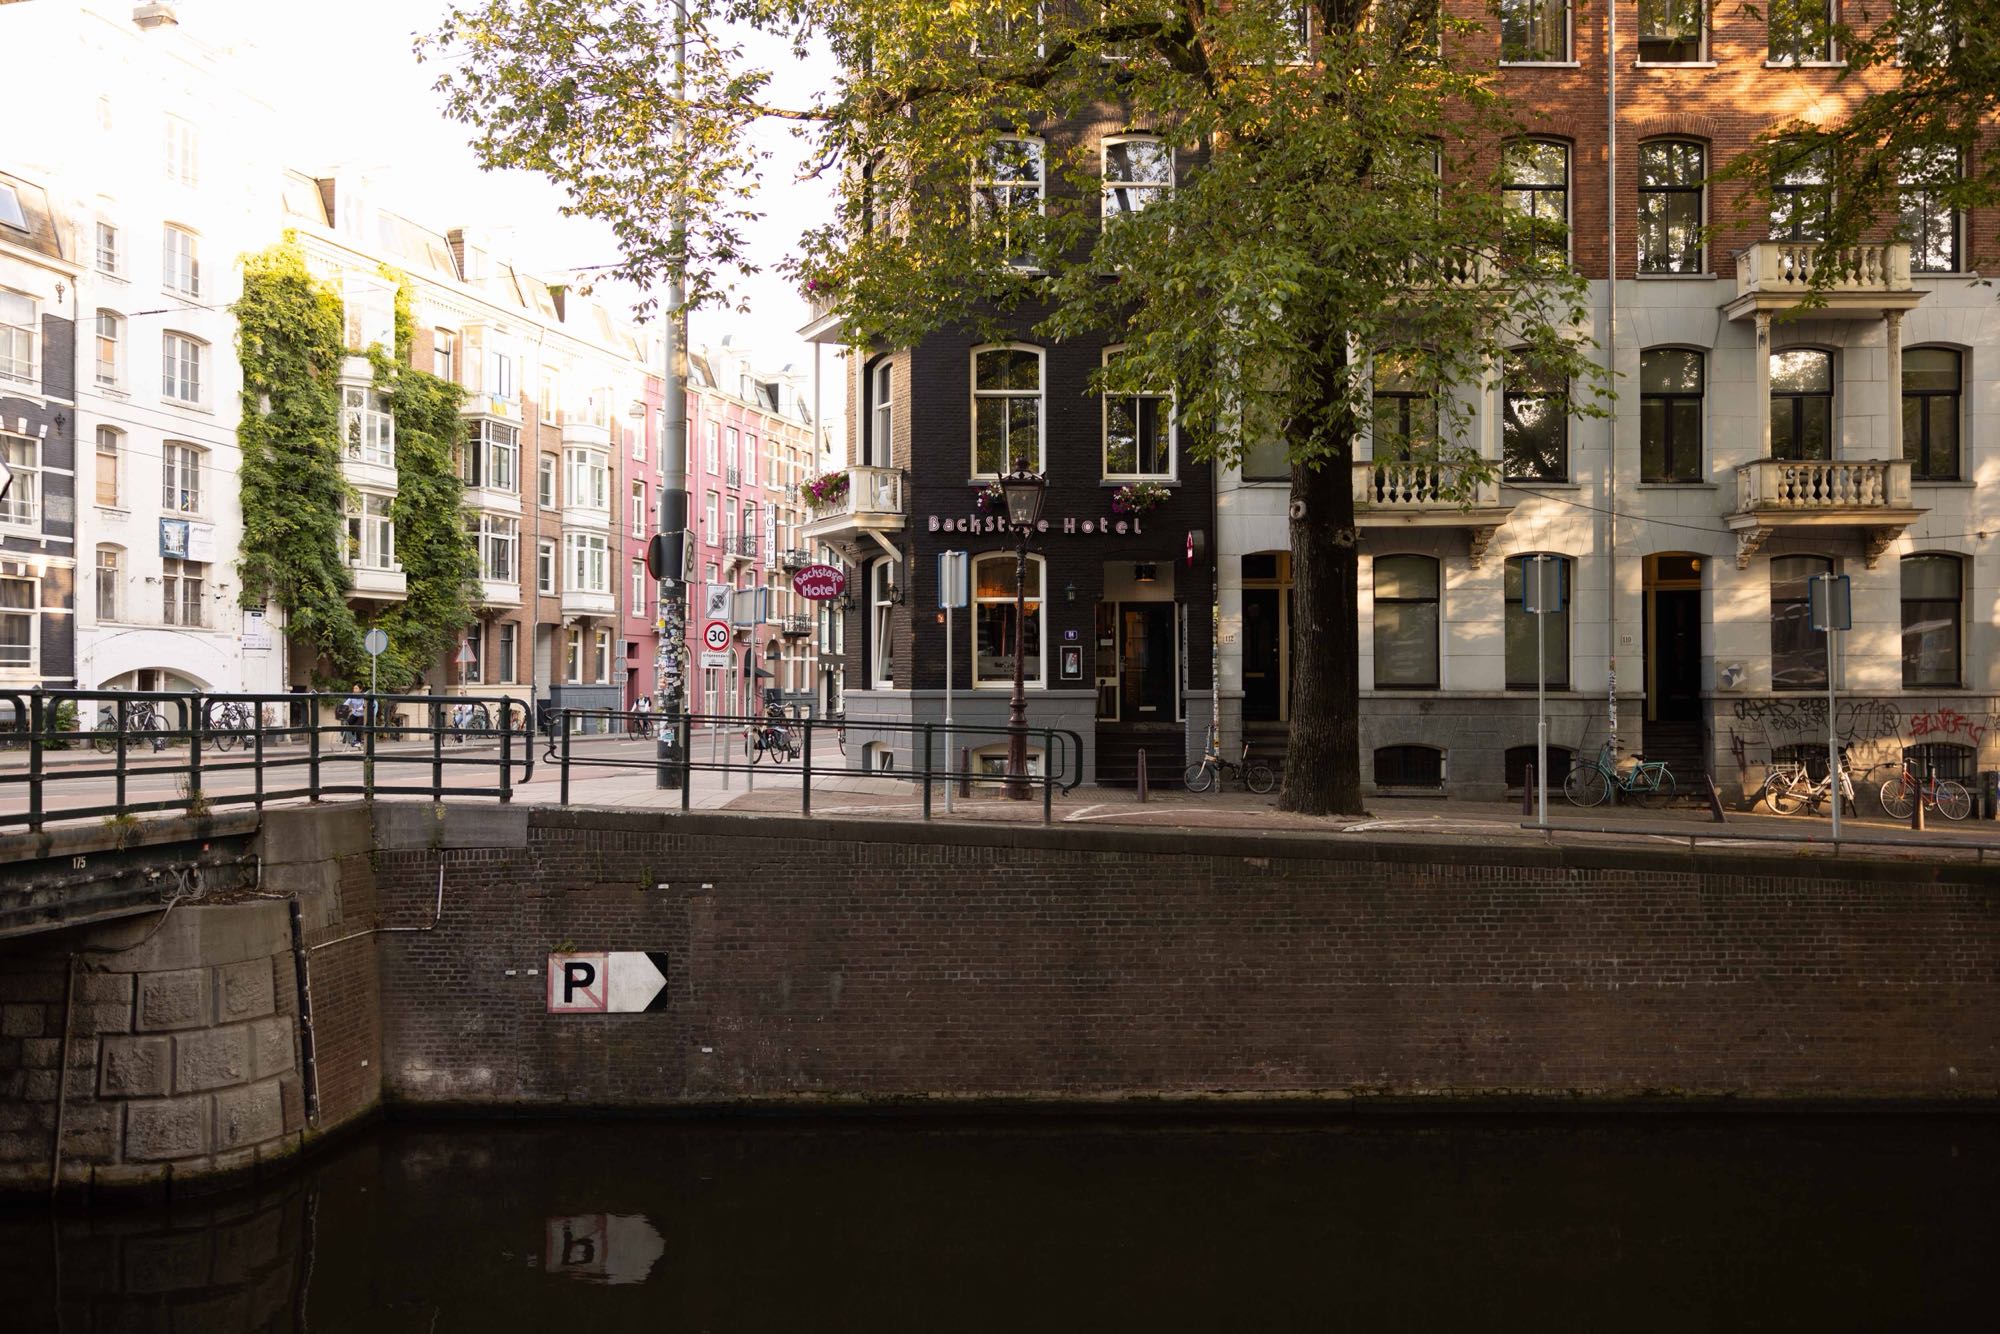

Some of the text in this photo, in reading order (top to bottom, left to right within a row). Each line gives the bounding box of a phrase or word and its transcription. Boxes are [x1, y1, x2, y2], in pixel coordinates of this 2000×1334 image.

[1063, 517, 1142, 534] Hotel
[766, 505, 775, 563] HOTEL
[803, 583, 837, 596] Hotel
[709, 630, 726, 642] 30
[73, 856, 86, 869] 175
[564, 962, 596, 1003] P
